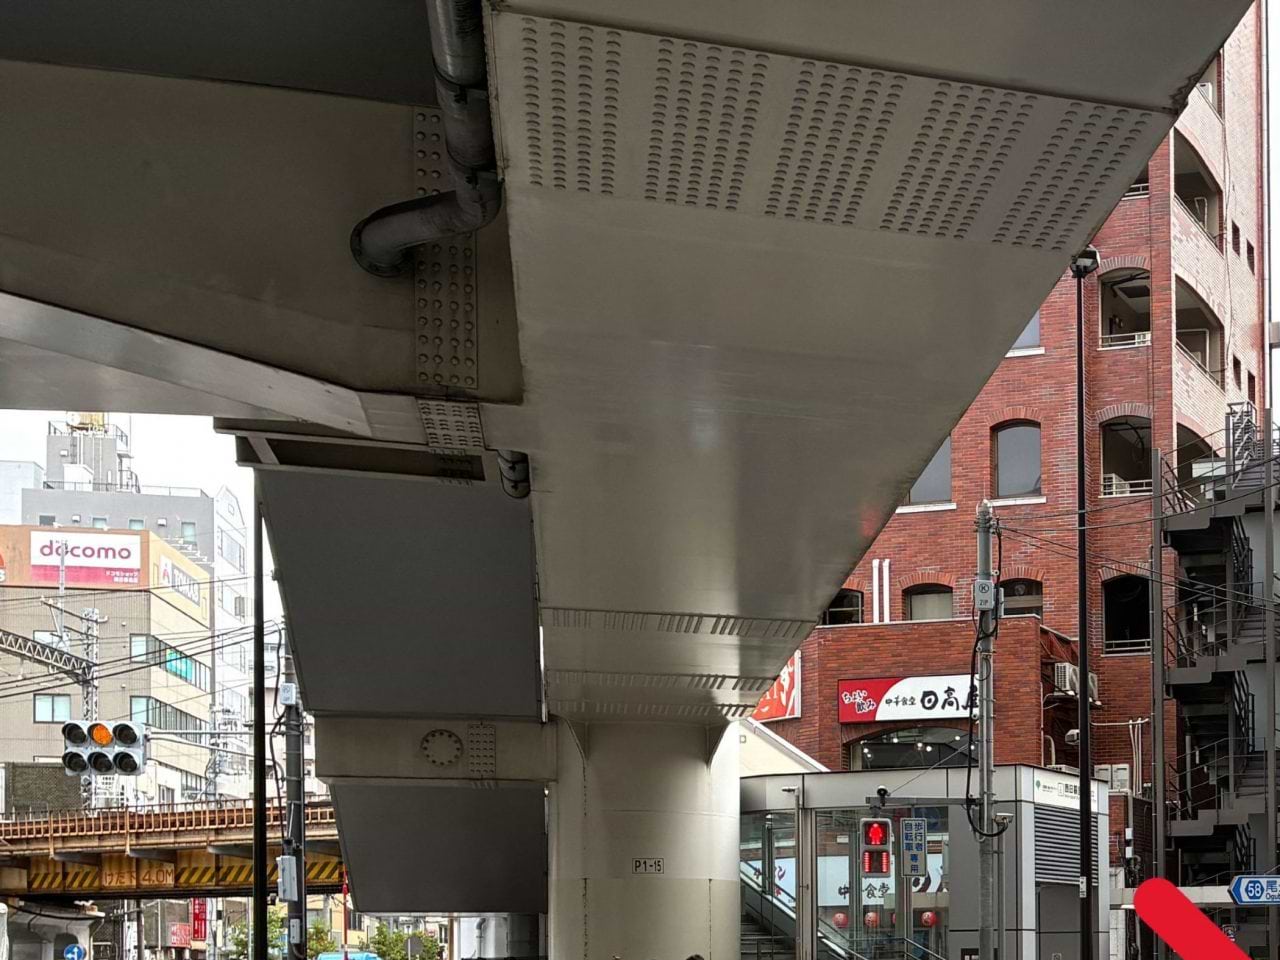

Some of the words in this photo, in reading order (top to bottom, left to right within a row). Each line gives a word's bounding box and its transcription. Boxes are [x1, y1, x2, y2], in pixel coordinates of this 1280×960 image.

[40, 539, 132, 560] docomo
[634, 860, 662, 872] P1-15
[838, 882, 890, 900] 中食堂
[1248, 883, 1262, 897] 58
